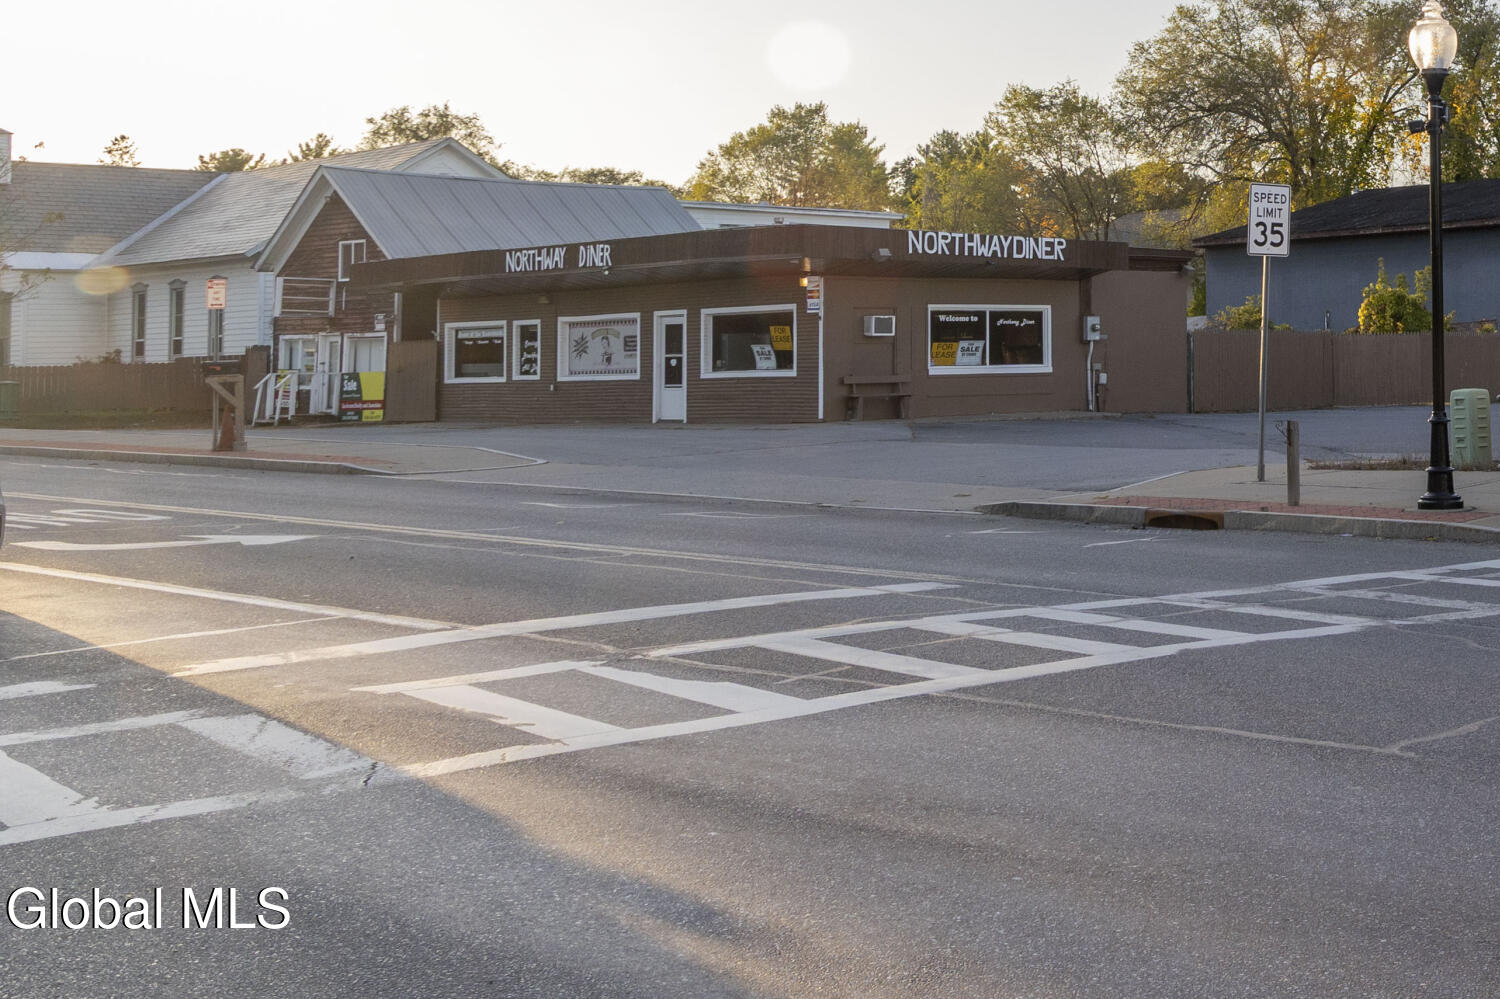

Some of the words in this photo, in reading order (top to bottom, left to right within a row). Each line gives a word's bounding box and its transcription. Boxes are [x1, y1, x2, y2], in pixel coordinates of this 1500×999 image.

[1254, 192, 1287, 204] SPEED
[1256, 207, 1283, 218] LIMIT
[1254, 221, 1284, 248] 35
[505, 246, 567, 273] NORTHWAY
[938, 314, 970, 322] Welcome
